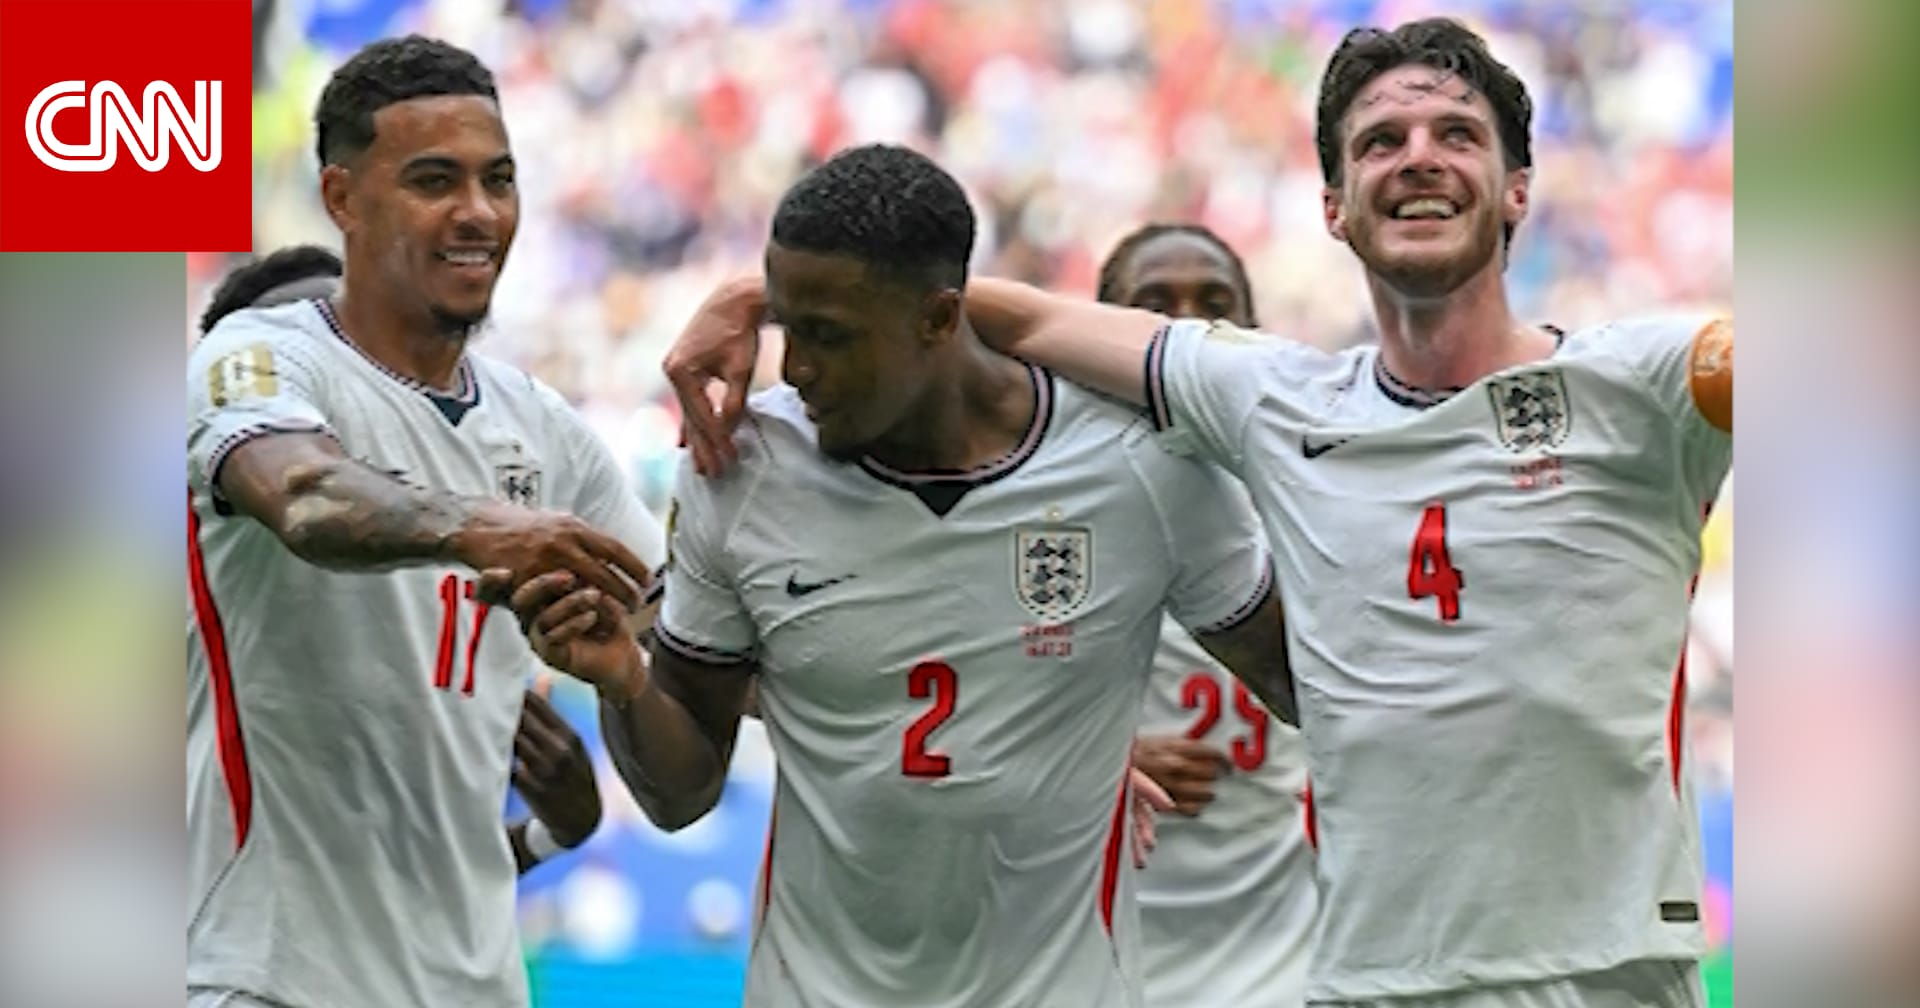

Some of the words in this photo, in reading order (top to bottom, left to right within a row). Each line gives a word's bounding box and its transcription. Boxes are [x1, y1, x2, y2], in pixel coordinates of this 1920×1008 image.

[1407, 504, 1465, 621] 4
[434, 573, 489, 694] 17
[901, 660, 957, 778] 2
